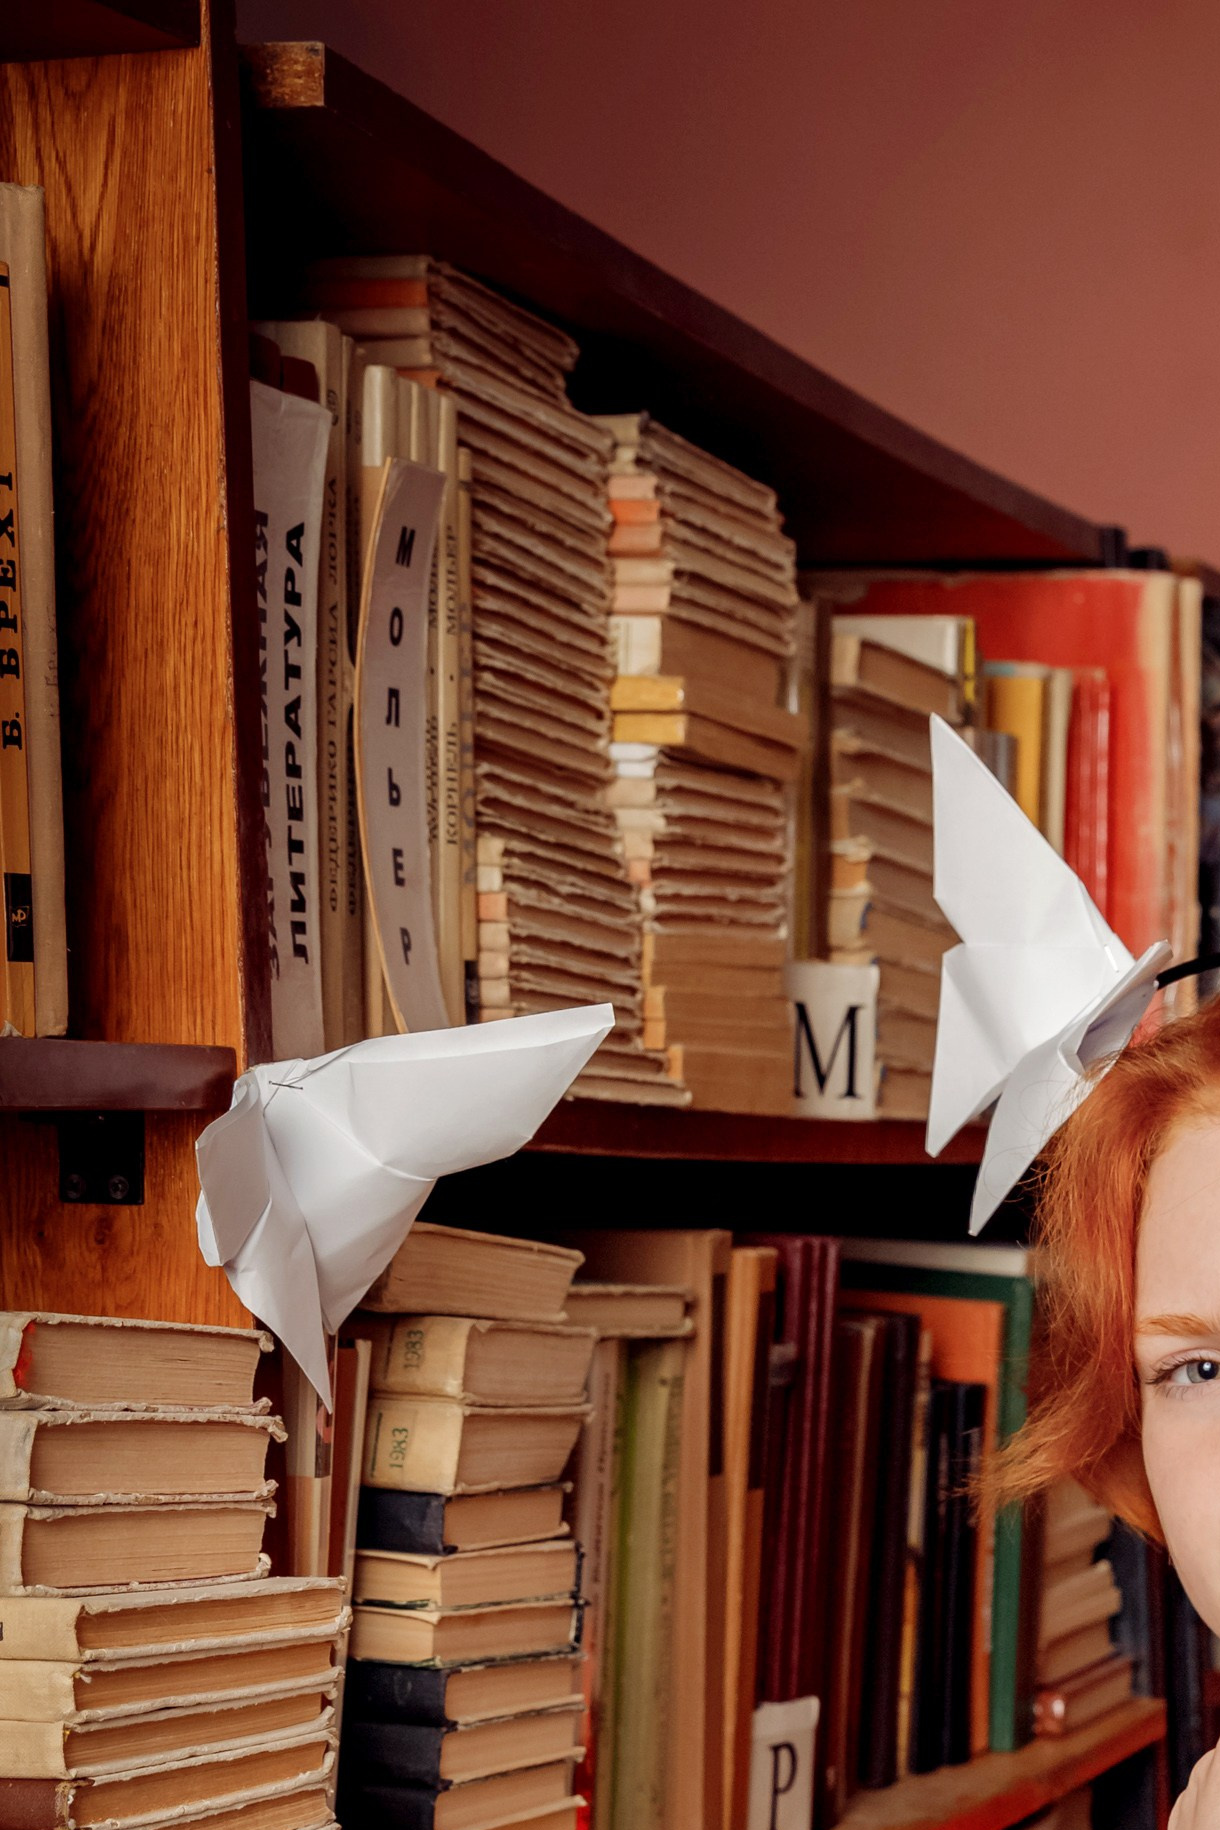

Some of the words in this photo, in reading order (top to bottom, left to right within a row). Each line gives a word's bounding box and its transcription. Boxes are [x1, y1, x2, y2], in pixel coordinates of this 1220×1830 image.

[327, 477, 338, 586] ЛОРКА
[446, 524, 458, 636] МОЛЬЕР
[2, 711, 22, 750] Б.
[283, 521, 309, 965] ЛИТЕРАТУРА
[385, 525, 416, 966] МОЛЬЕР
[446, 722, 458, 844] КОРНЕЛЬ
[327, 738, 341, 912] ФЕДЕРИКО
[793, 1001, 867, 1100] М
[402, 1329, 425, 1370] 1983
[388, 1427, 409, 1469] 1983
